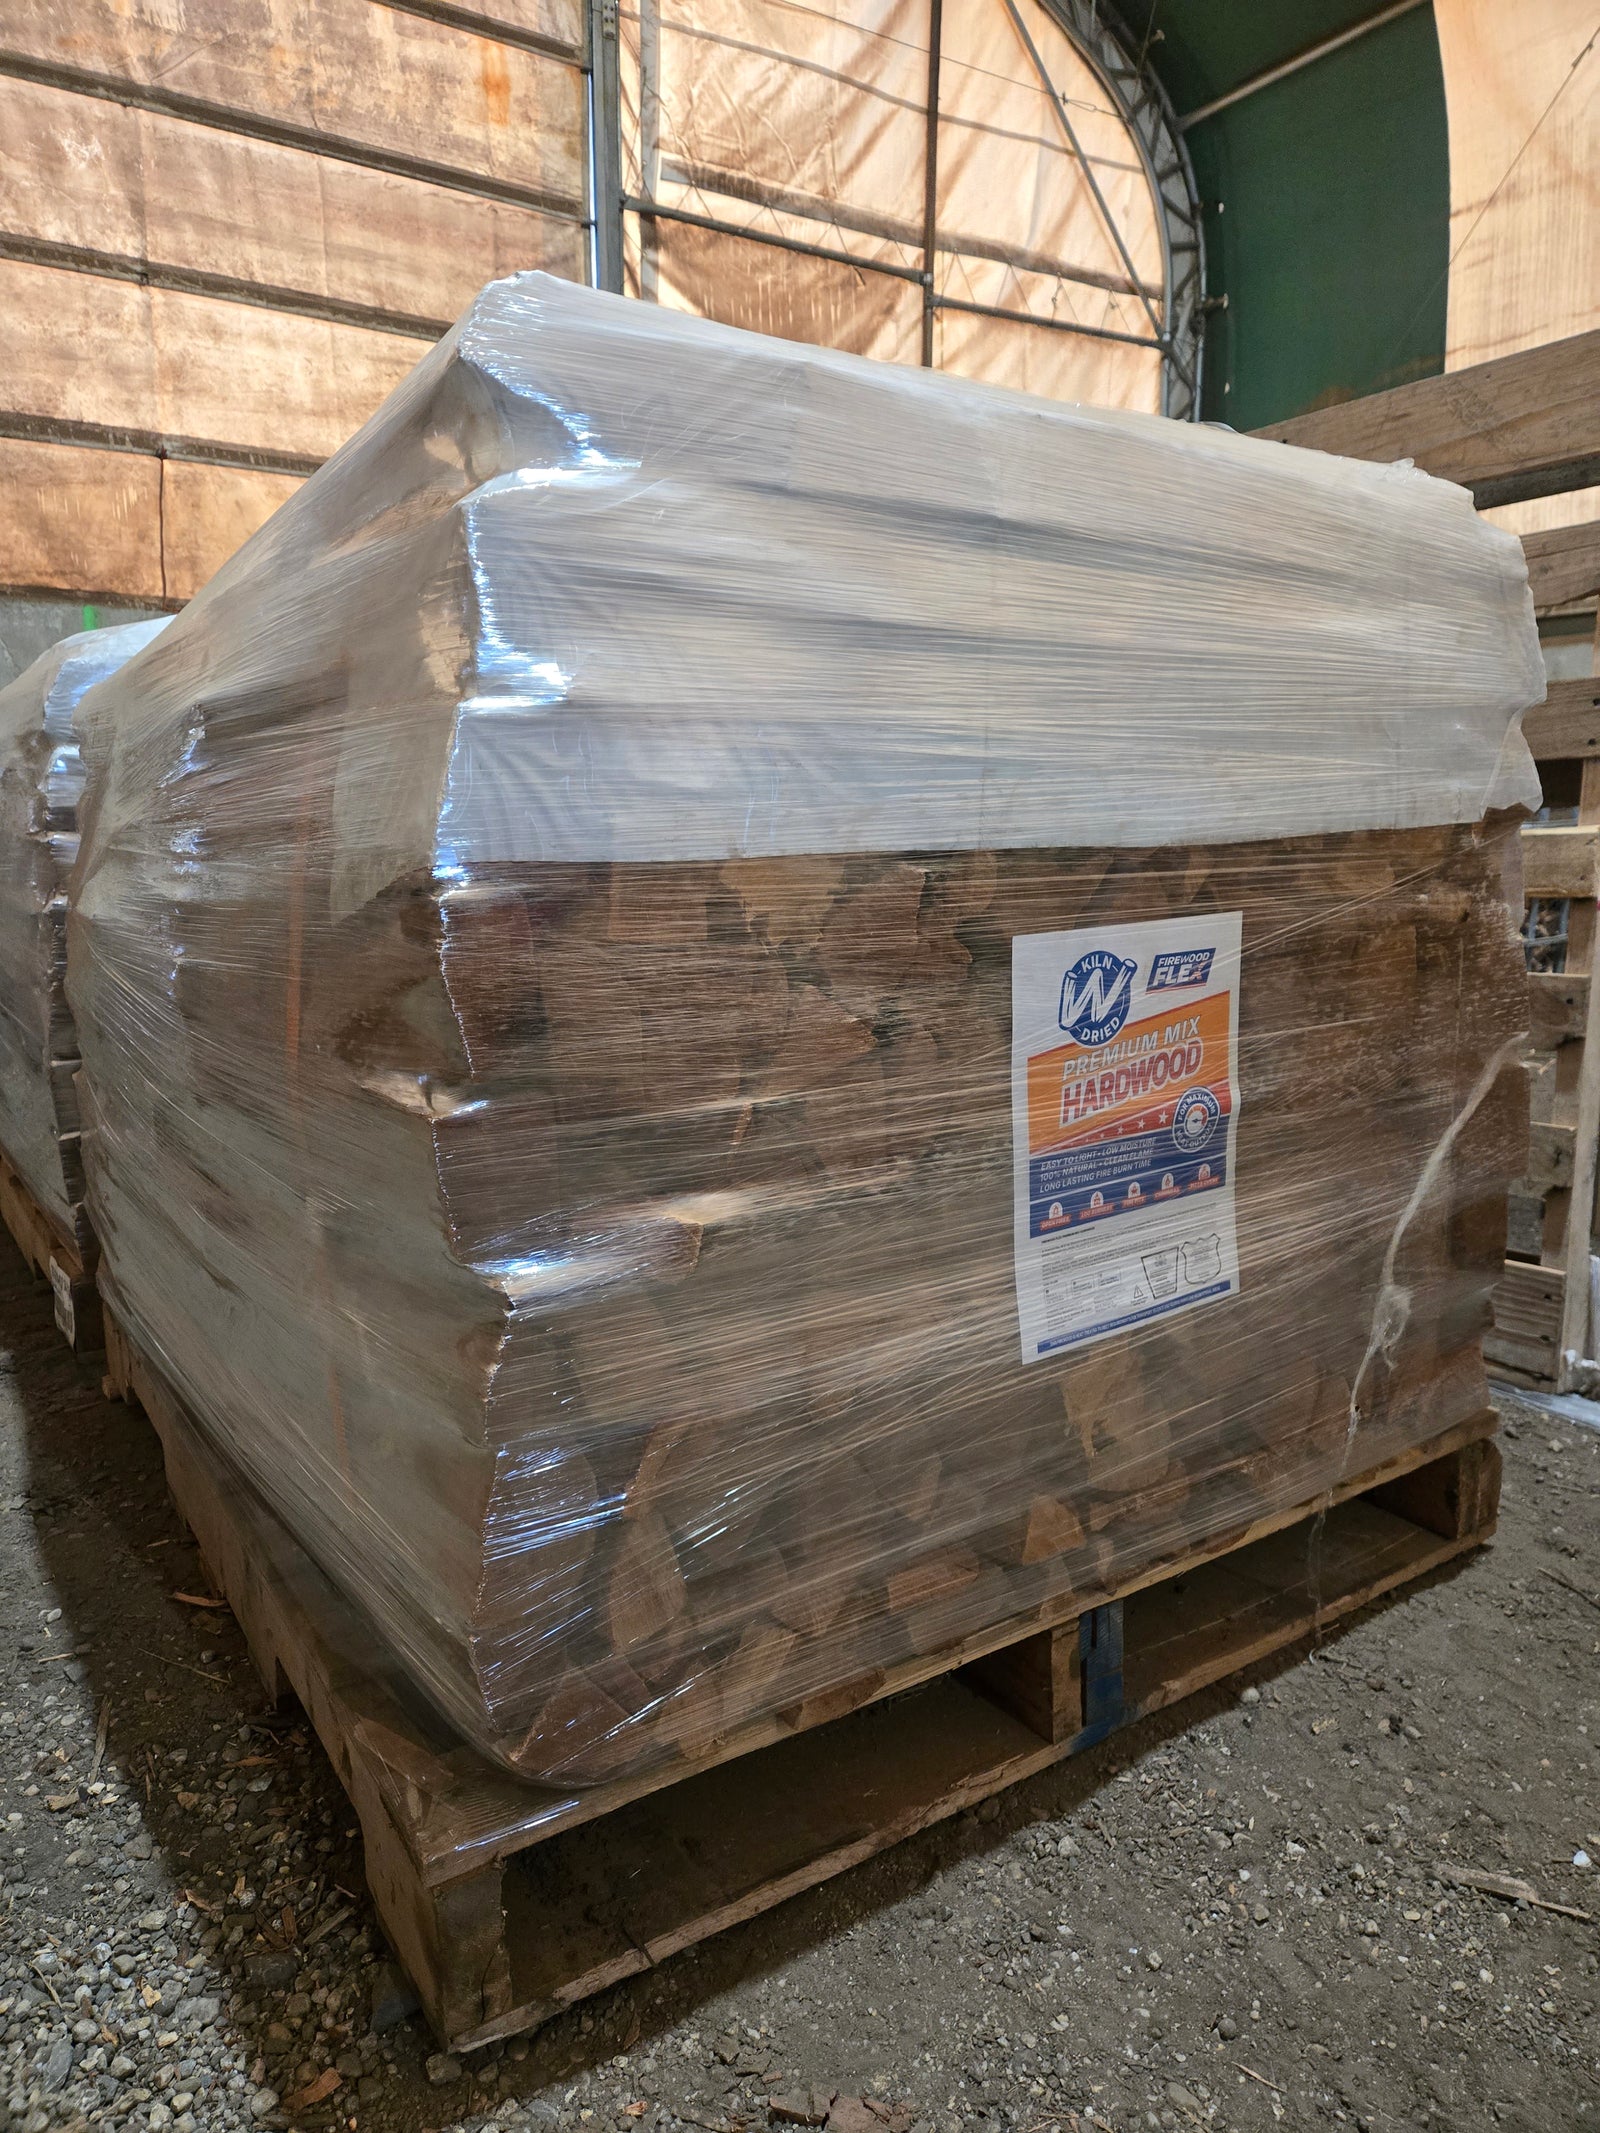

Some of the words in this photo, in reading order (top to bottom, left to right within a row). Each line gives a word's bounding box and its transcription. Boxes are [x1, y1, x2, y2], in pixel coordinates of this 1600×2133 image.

[1081, 955, 1113, 973] KILN
[1158, 952, 1210, 966] FIREWOOD
[1152, 960, 1209, 987] FLEX
[1081, 1017, 1120, 1042] DRIED
[1063, 1031, 1159, 1080] PREMIUM
[1164, 1016, 1200, 1045] MIX
[1061, 1039, 1202, 1126] HARDWOOD
[1178, 1103, 1188, 1120] FOR
[1186, 1093, 1216, 1114] MAXIMUM
[1041, 1158, 1063, 1171] EASY
[1064, 1156, 1075, 1165] TO
[1074, 1151, 1097, 1163] LIGHT
[1102, 1146, 1118, 1155] LOW
[1119, 1137, 1157, 1152] MOISTURE
[1040, 1170, 1061, 1182] 100%
[1062, 1163, 1097, 1176] NATURAL
[1040, 1180, 1061, 1193] LONG
[1062, 1173, 1095, 1188] LASTING
[1096, 1167, 1112, 1179] FIRE
[1112, 1162, 1133, 1175] BURN
[1133, 1158, 1152, 1169] TIME
